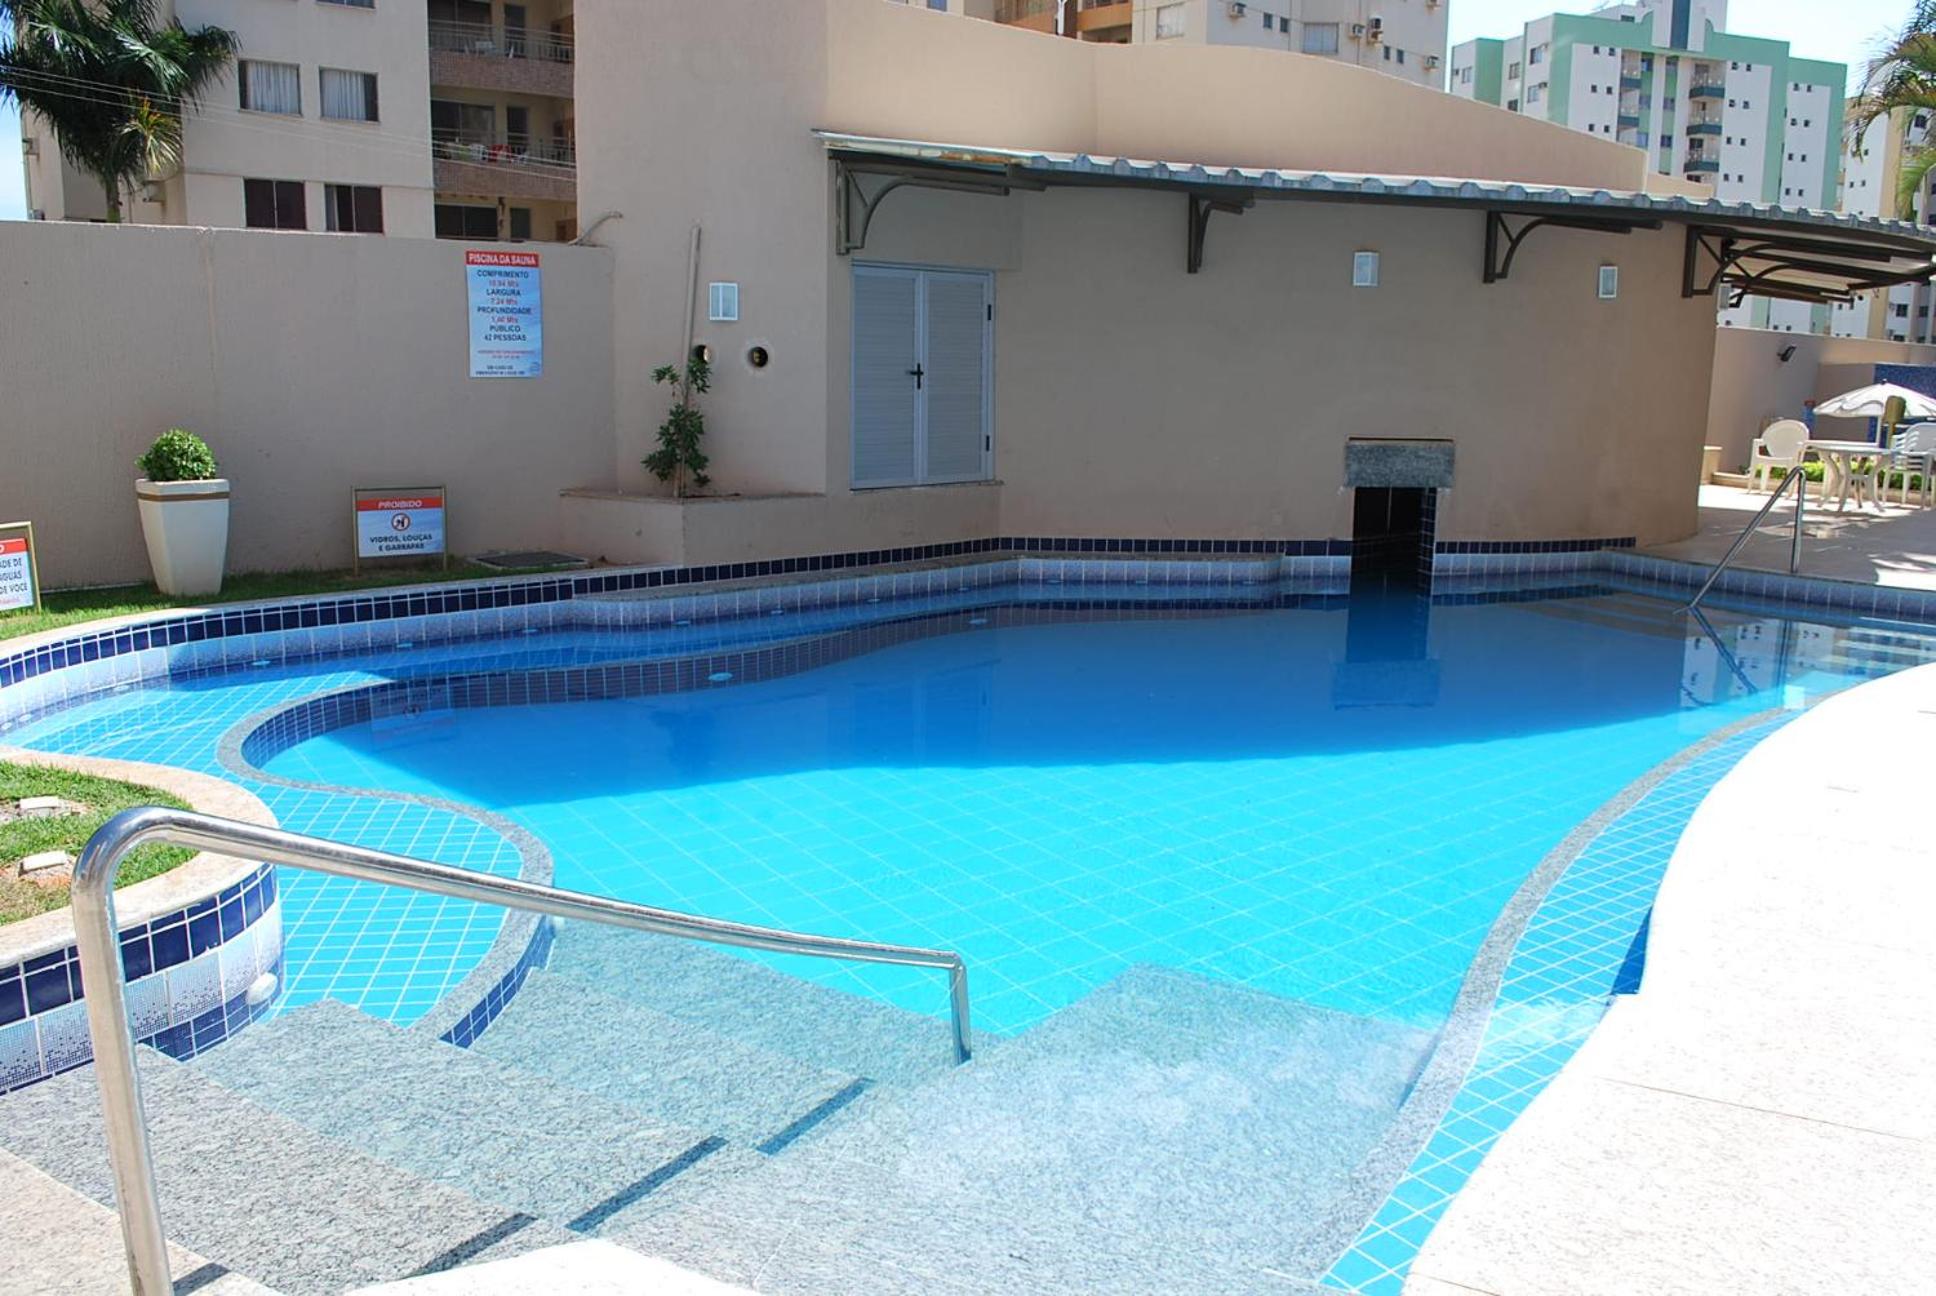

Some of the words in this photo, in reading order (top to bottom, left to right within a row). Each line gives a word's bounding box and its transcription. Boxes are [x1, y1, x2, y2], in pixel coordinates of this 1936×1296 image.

[468, 252, 498, 263] PISCINA
[500, 254, 510, 264] DA
[511, 254, 536, 265] SAUNA
[476, 270, 529, 278] COMPRIMENTO
[486, 288, 521, 296] LARGURA
[476, 306, 532, 315] PROFUNDIDADE
[378, 500, 422, 508] PROIBIDO
[385, 543, 425, 552] GARRAFAS
